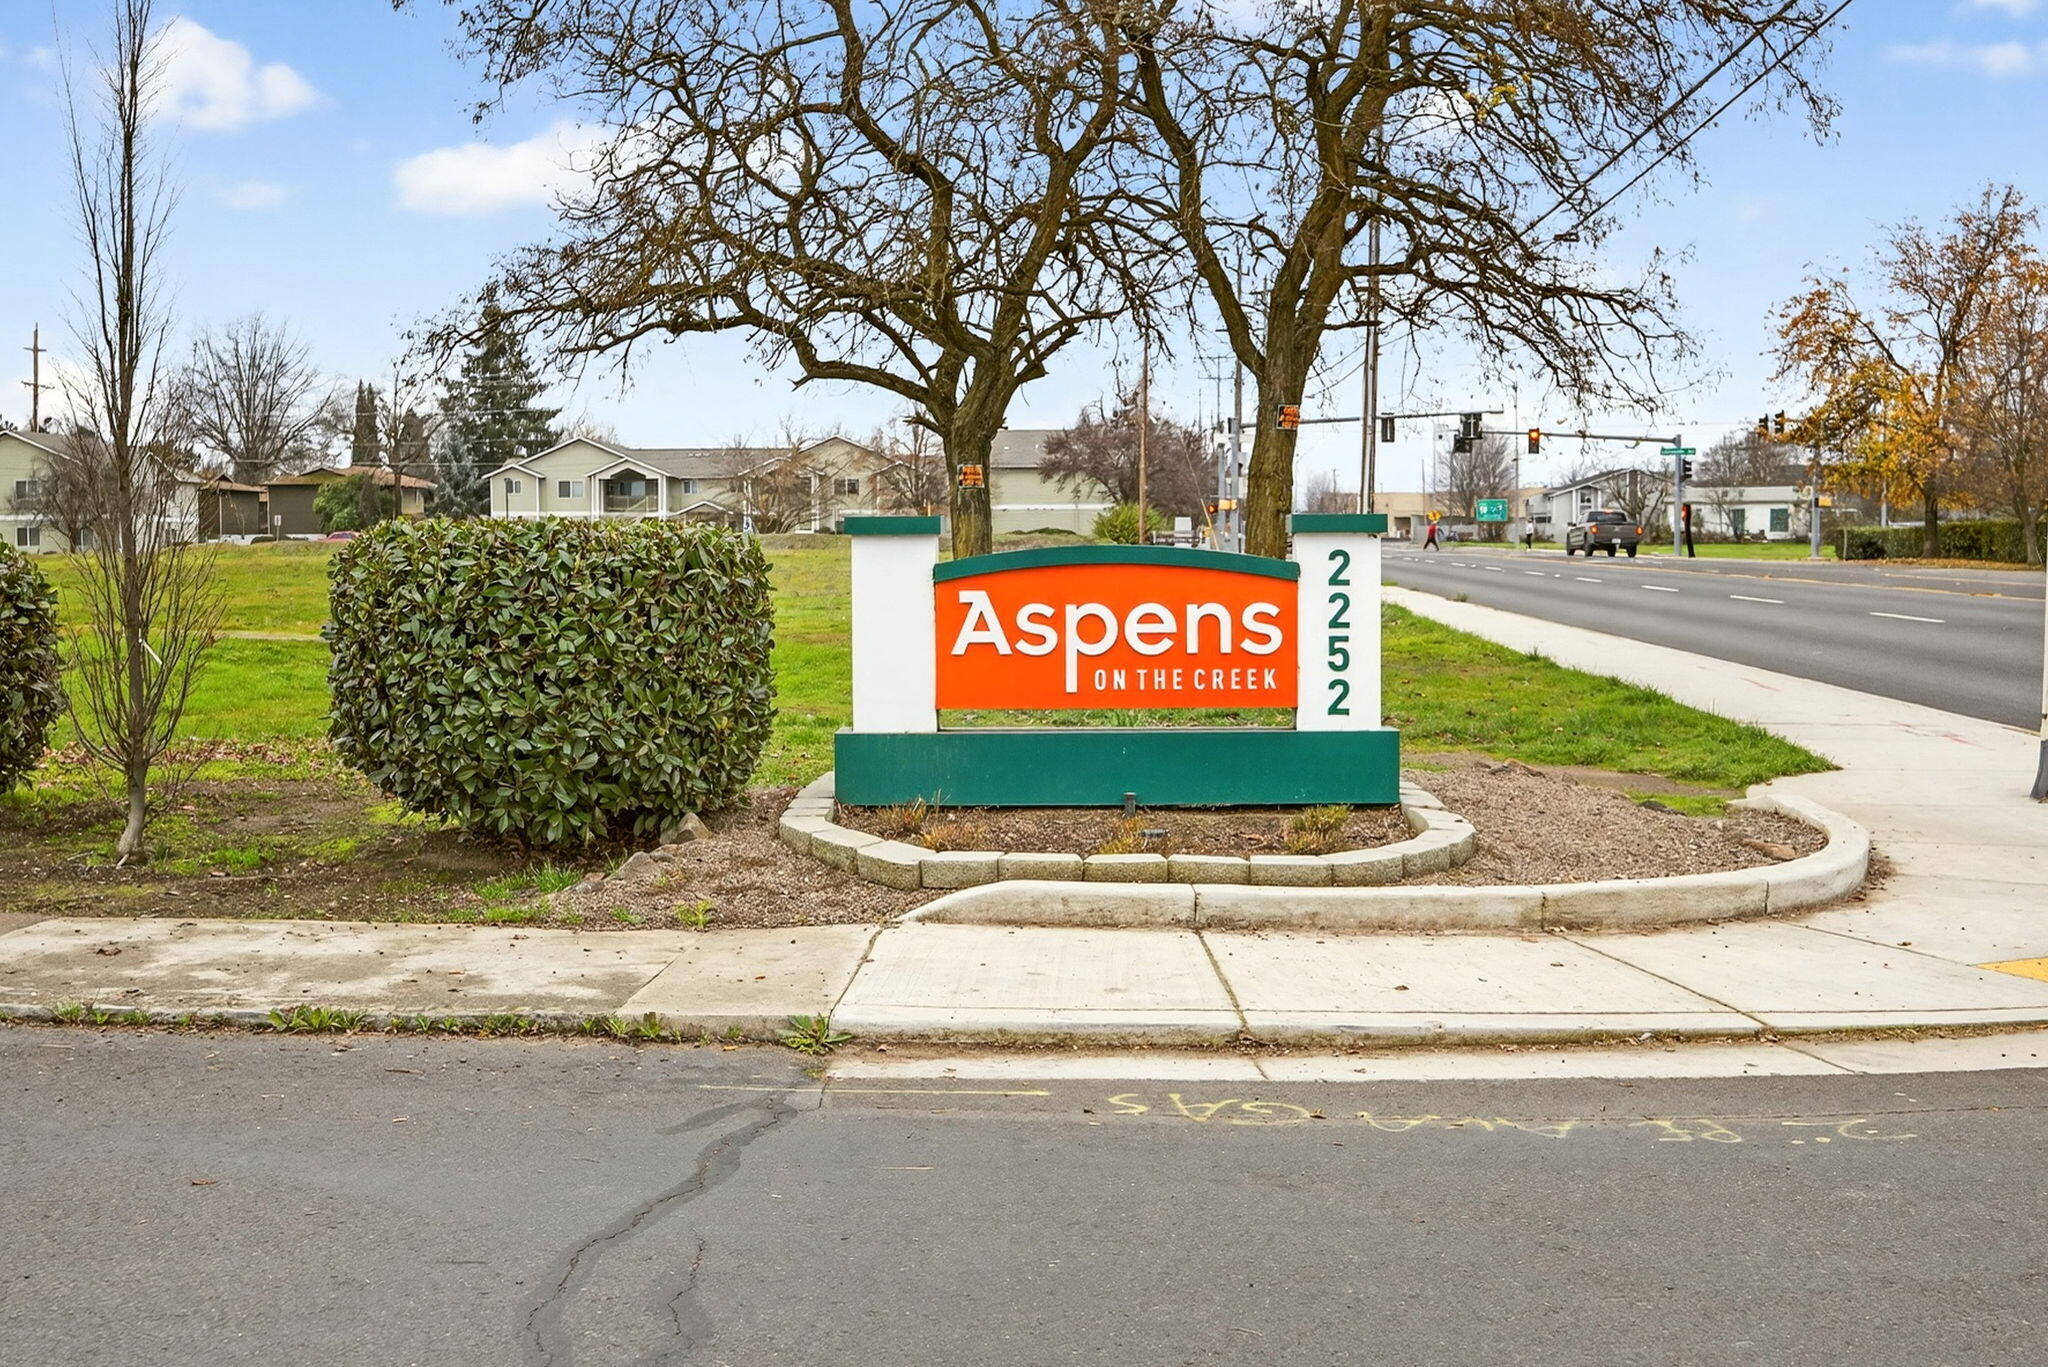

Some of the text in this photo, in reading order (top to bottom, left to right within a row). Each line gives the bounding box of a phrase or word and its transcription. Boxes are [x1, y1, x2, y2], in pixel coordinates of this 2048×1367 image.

[950, 590, 1284, 693] Aspens
[1327, 549, 1351, 716] 2252
[1094, 667, 1277, 690] ON THE CREEK
[1107, 1093, 1310, 1126] GAS
